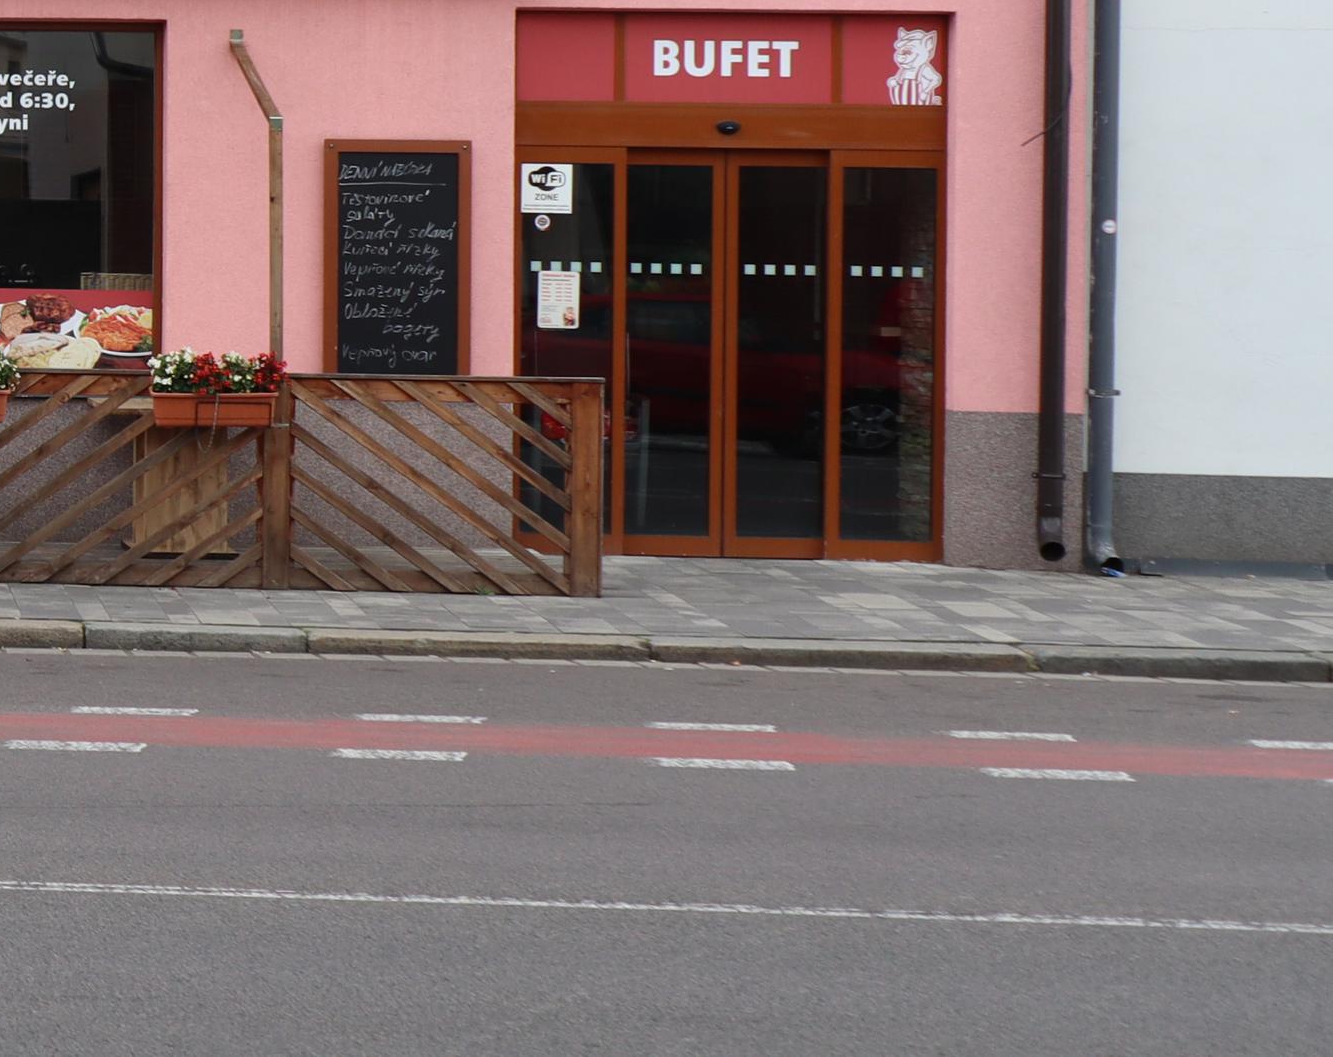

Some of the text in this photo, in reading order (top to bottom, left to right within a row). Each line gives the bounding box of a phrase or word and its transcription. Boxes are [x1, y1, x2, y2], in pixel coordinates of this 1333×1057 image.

[652, 39, 800, 79] BUFET
[19, 93, 76, 111] 6:30,
[535, 193, 560, 201] ZONE
